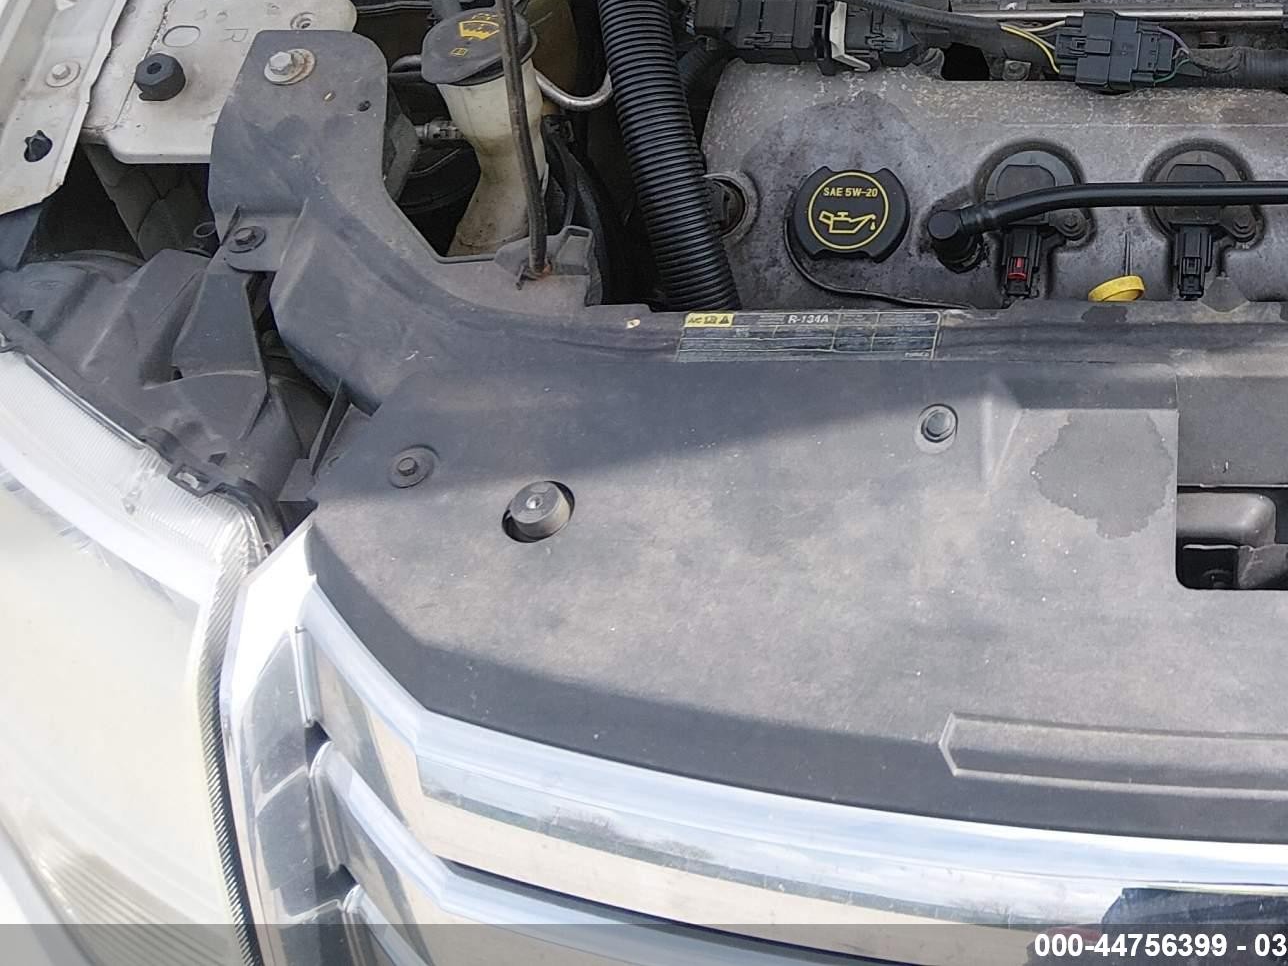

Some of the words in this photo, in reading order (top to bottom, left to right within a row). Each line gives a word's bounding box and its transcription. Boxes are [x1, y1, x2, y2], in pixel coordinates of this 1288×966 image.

[823, 187, 843, 196] SAE
[844, 187, 879, 198] 5W-20
[787, 314, 829, 324] R-134A
